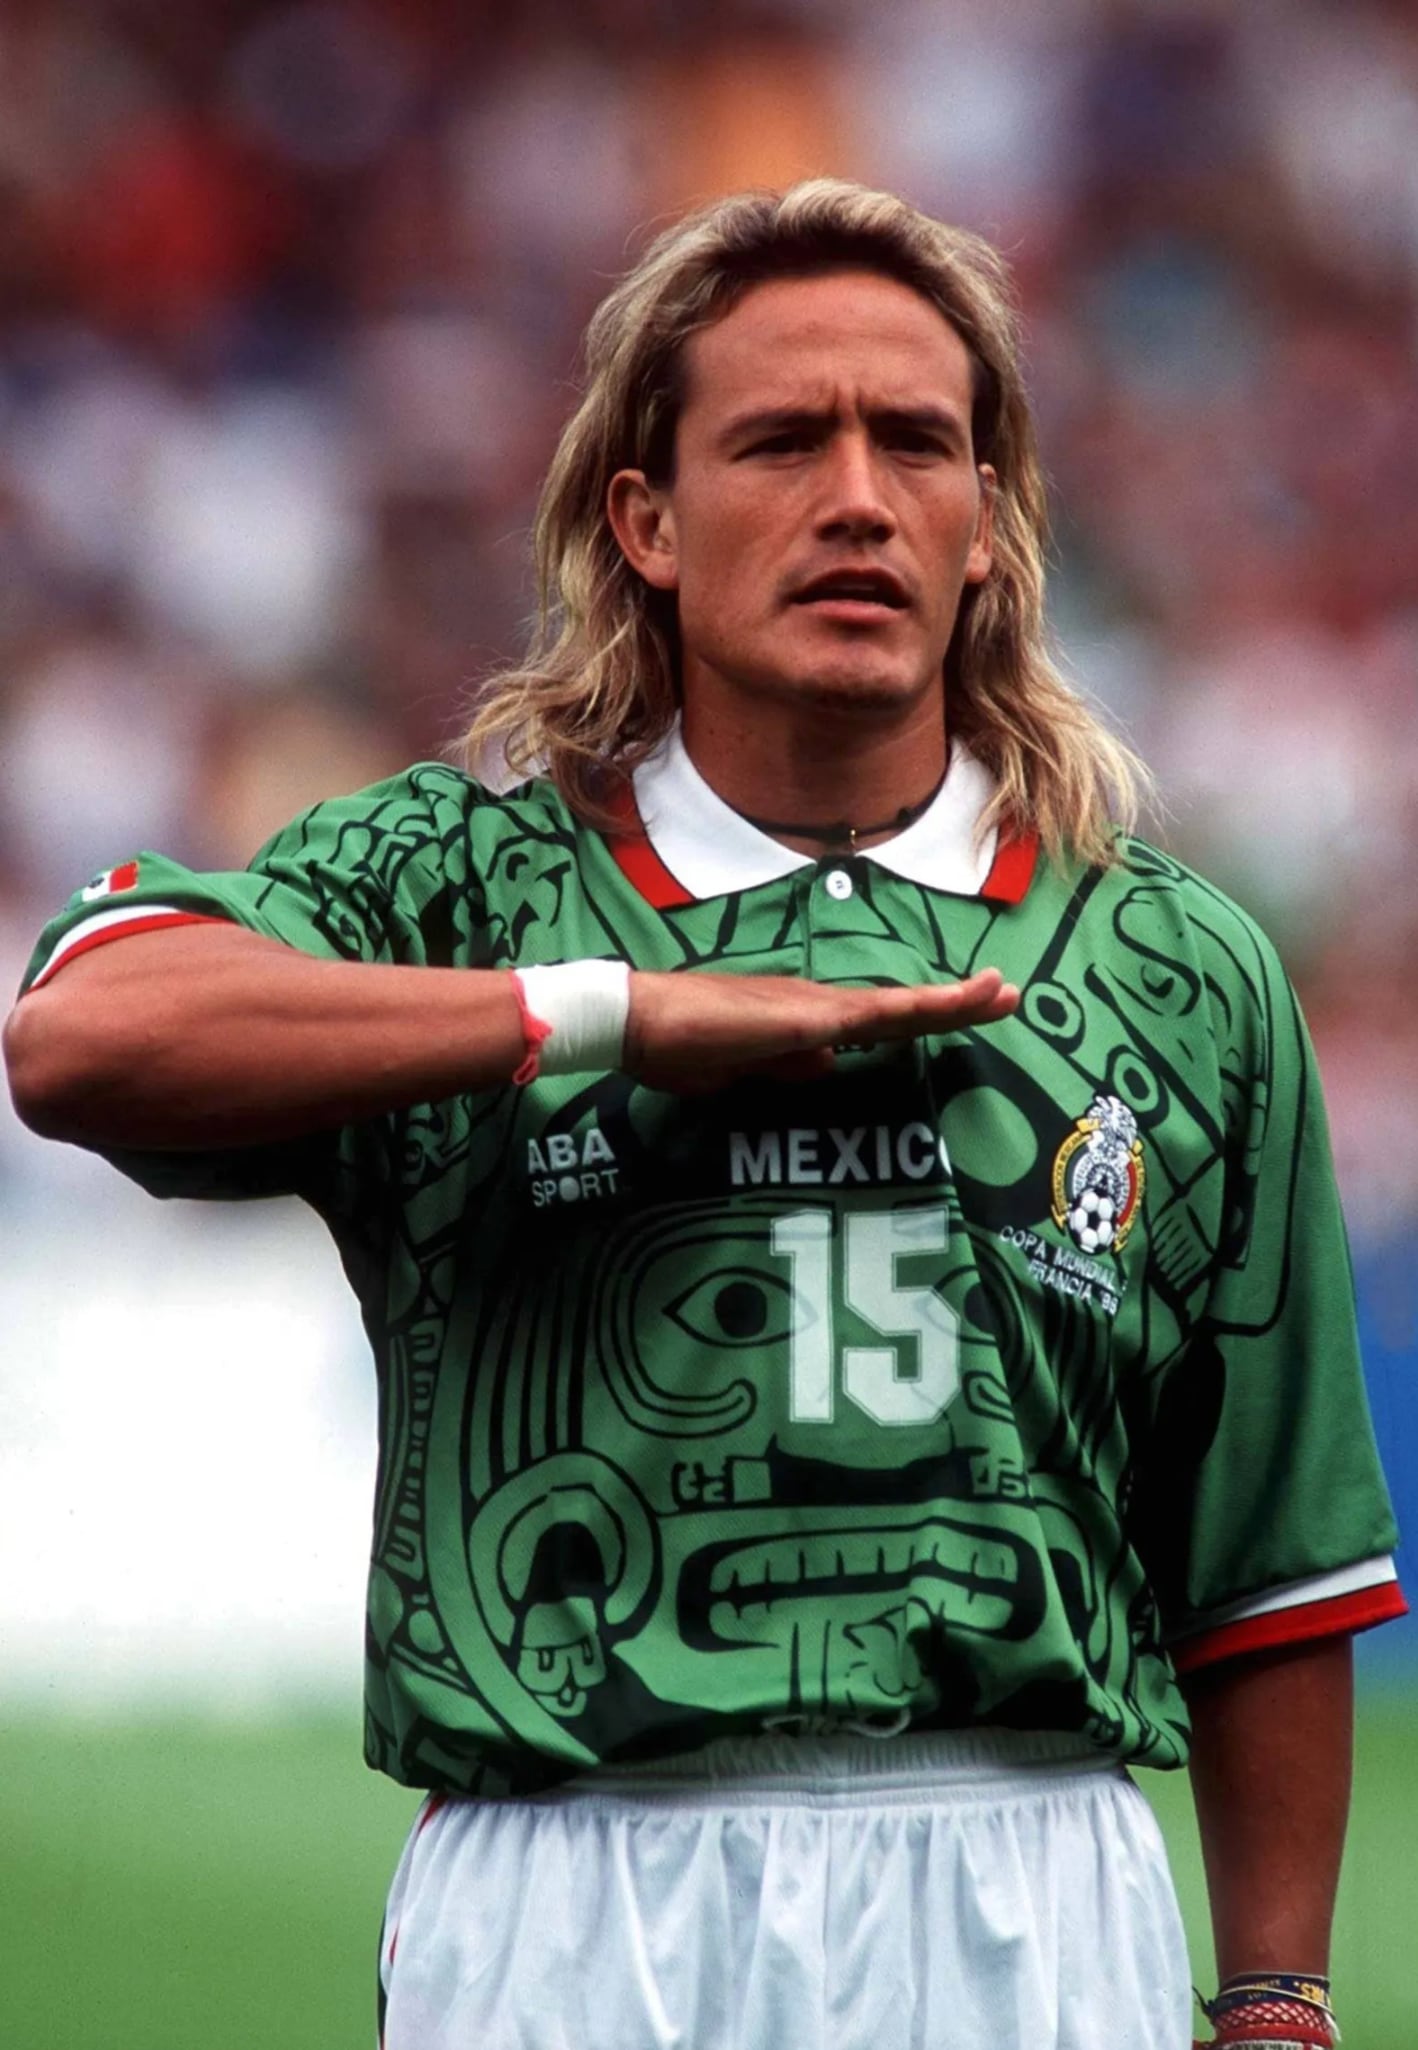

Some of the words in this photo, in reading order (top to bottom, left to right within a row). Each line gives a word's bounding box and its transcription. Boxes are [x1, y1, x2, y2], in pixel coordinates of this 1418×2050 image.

[527, 1127, 615, 1174] ABA
[729, 1122, 953, 1185] MEXIC
[532, 1168, 619, 1207] SPORT
[999, 1225, 1046, 1260] COPA
[1053, 1246, 1117, 1293] MUNDIAL
[1028, 1259, 1092, 1306] FRANCIA
[770, 1203, 961, 1426] 15
